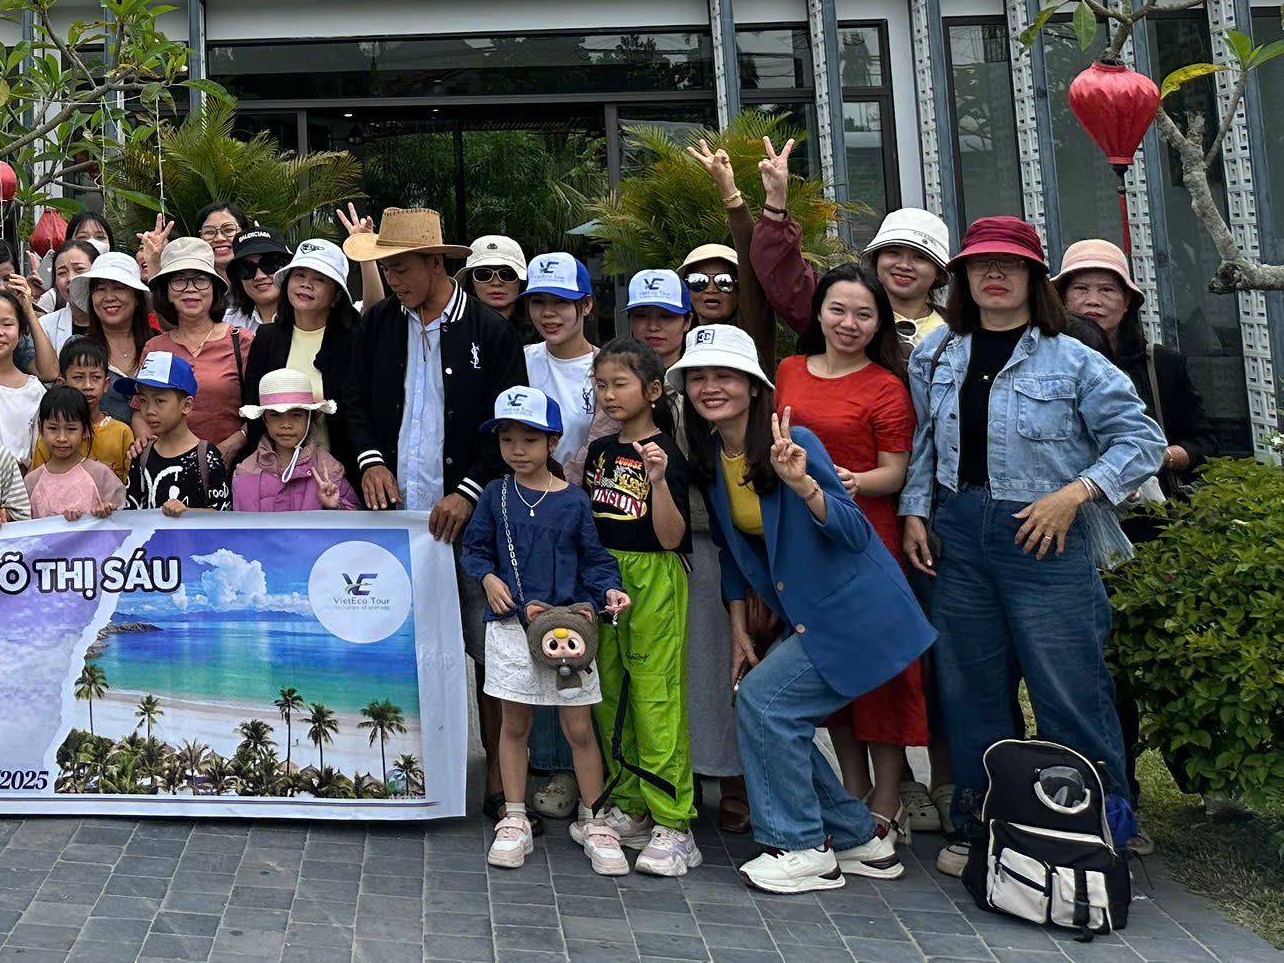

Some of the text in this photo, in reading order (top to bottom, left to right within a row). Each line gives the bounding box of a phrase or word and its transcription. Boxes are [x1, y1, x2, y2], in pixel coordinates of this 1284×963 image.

[33, 555, 97, 600] THỊ
[101, 548, 182, 594] SÁU
[371, 597, 390, 605] Tour
